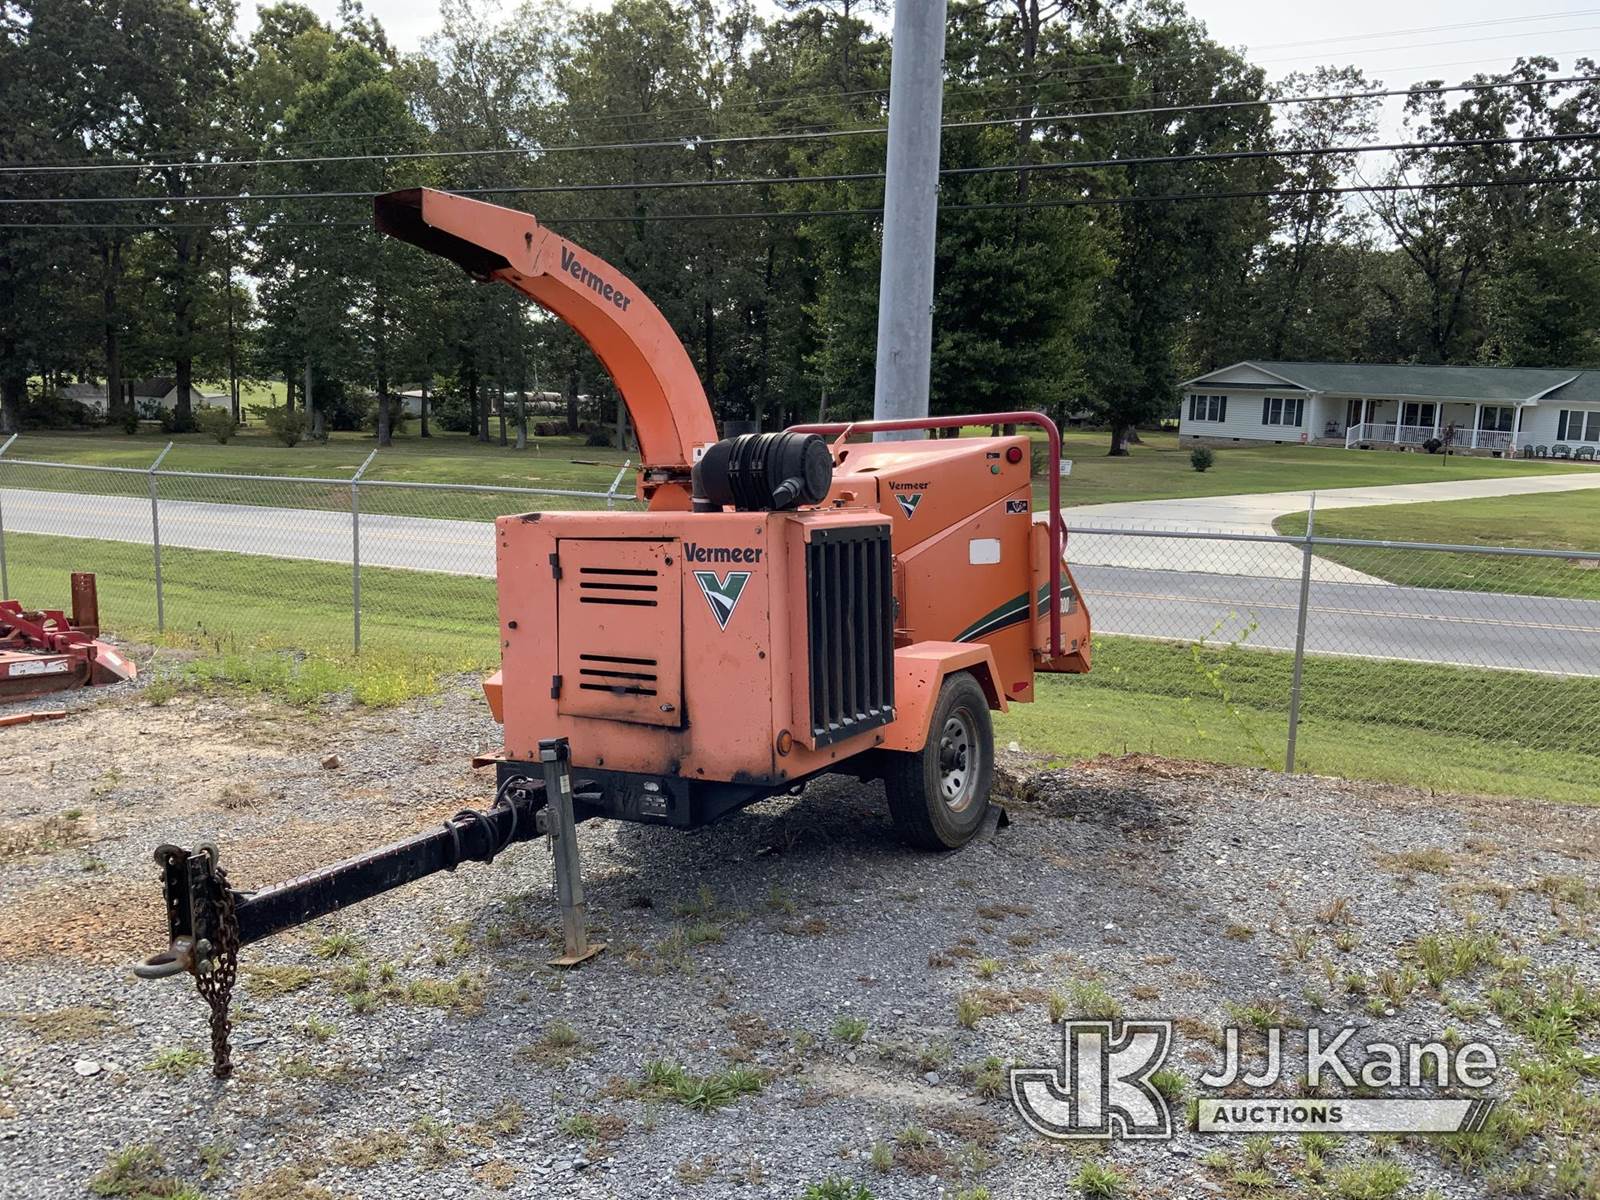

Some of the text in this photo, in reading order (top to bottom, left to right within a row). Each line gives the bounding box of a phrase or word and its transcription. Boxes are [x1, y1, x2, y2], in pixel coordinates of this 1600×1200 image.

[561, 246, 631, 312] Vermeer
[888, 481, 929, 490] Vermeer
[683, 542, 763, 563] Vermeer
